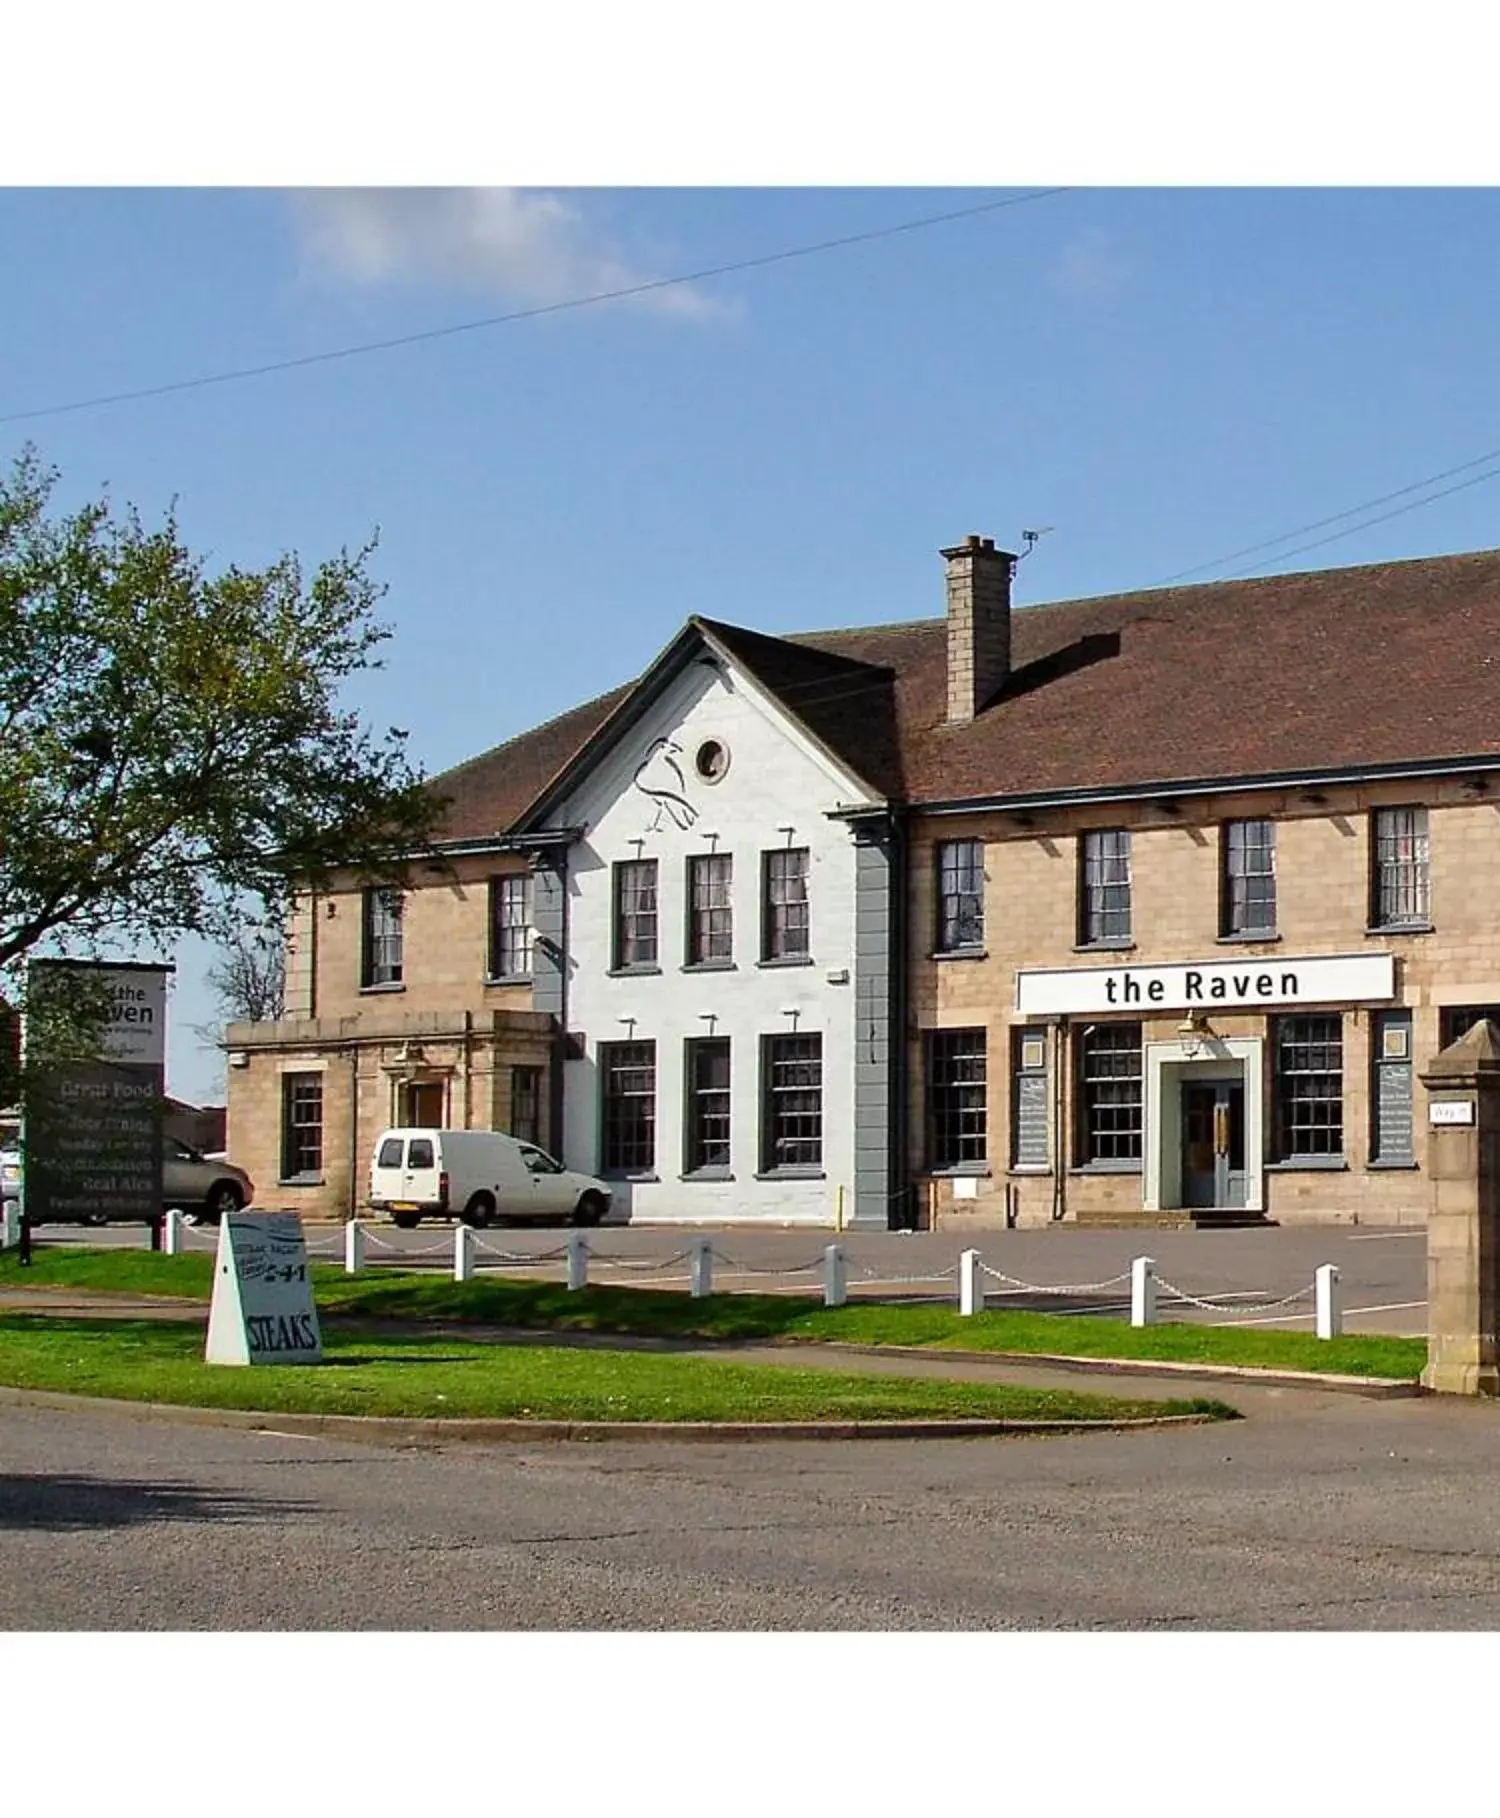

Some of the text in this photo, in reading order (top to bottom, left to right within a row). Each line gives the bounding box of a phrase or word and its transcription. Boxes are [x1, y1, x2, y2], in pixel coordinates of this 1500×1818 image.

[1105, 970, 1300, 1003] the Raven
[247, 1314, 318, 1352] STEAKS
